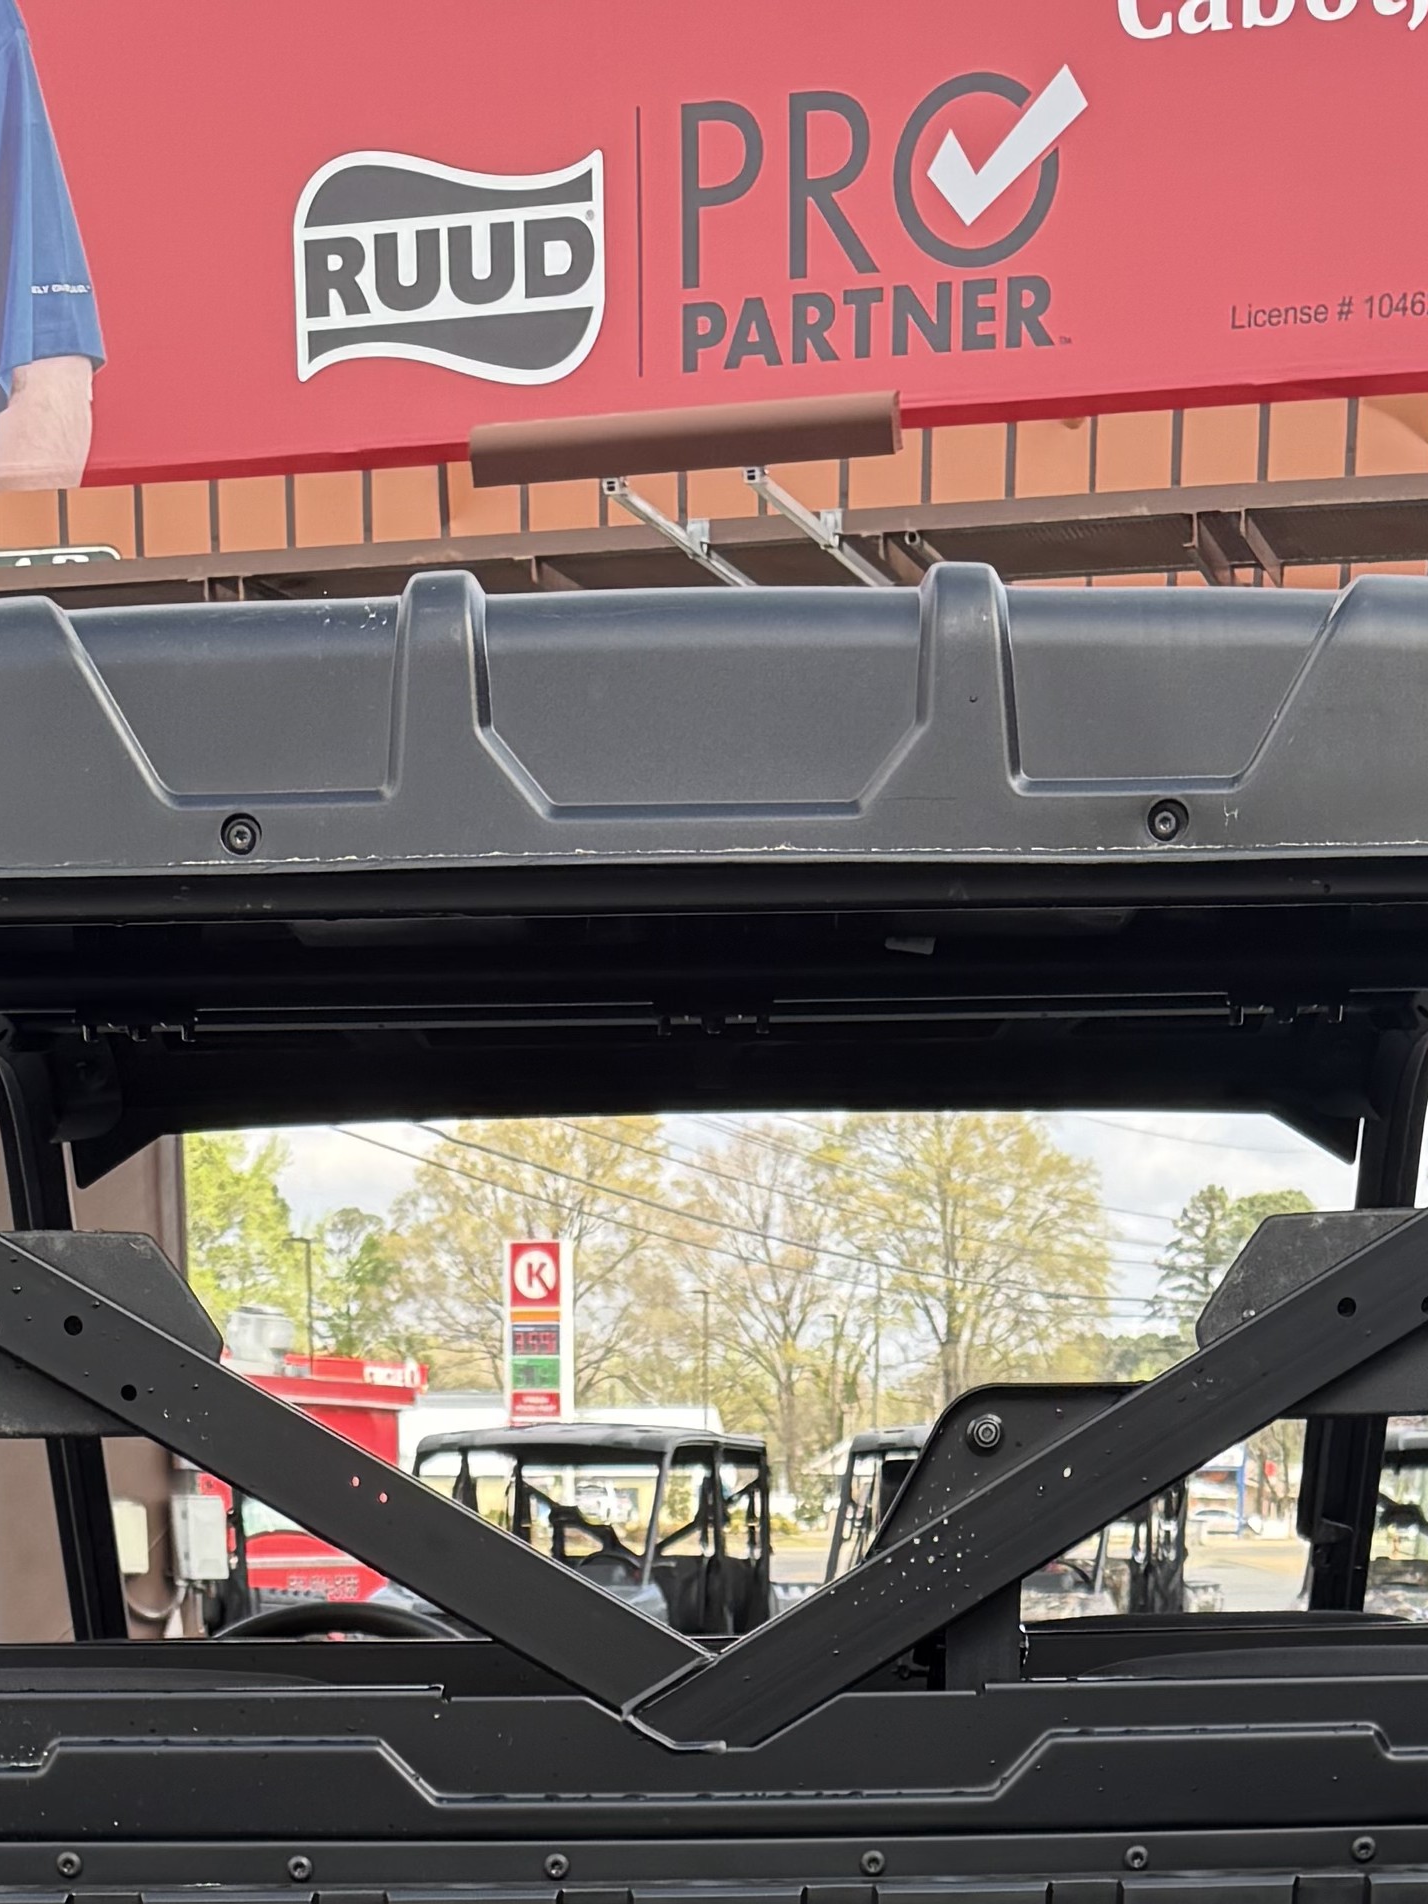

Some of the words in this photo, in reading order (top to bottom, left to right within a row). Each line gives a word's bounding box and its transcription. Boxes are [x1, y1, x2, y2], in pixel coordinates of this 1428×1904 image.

[680, 72, 1059, 289] PRO
[303, 215, 595, 319] RUUD
[1230, 303, 1329, 330] License
[1336, 295, 1354, 322] #
[680, 276, 1055, 374] PARTNER
